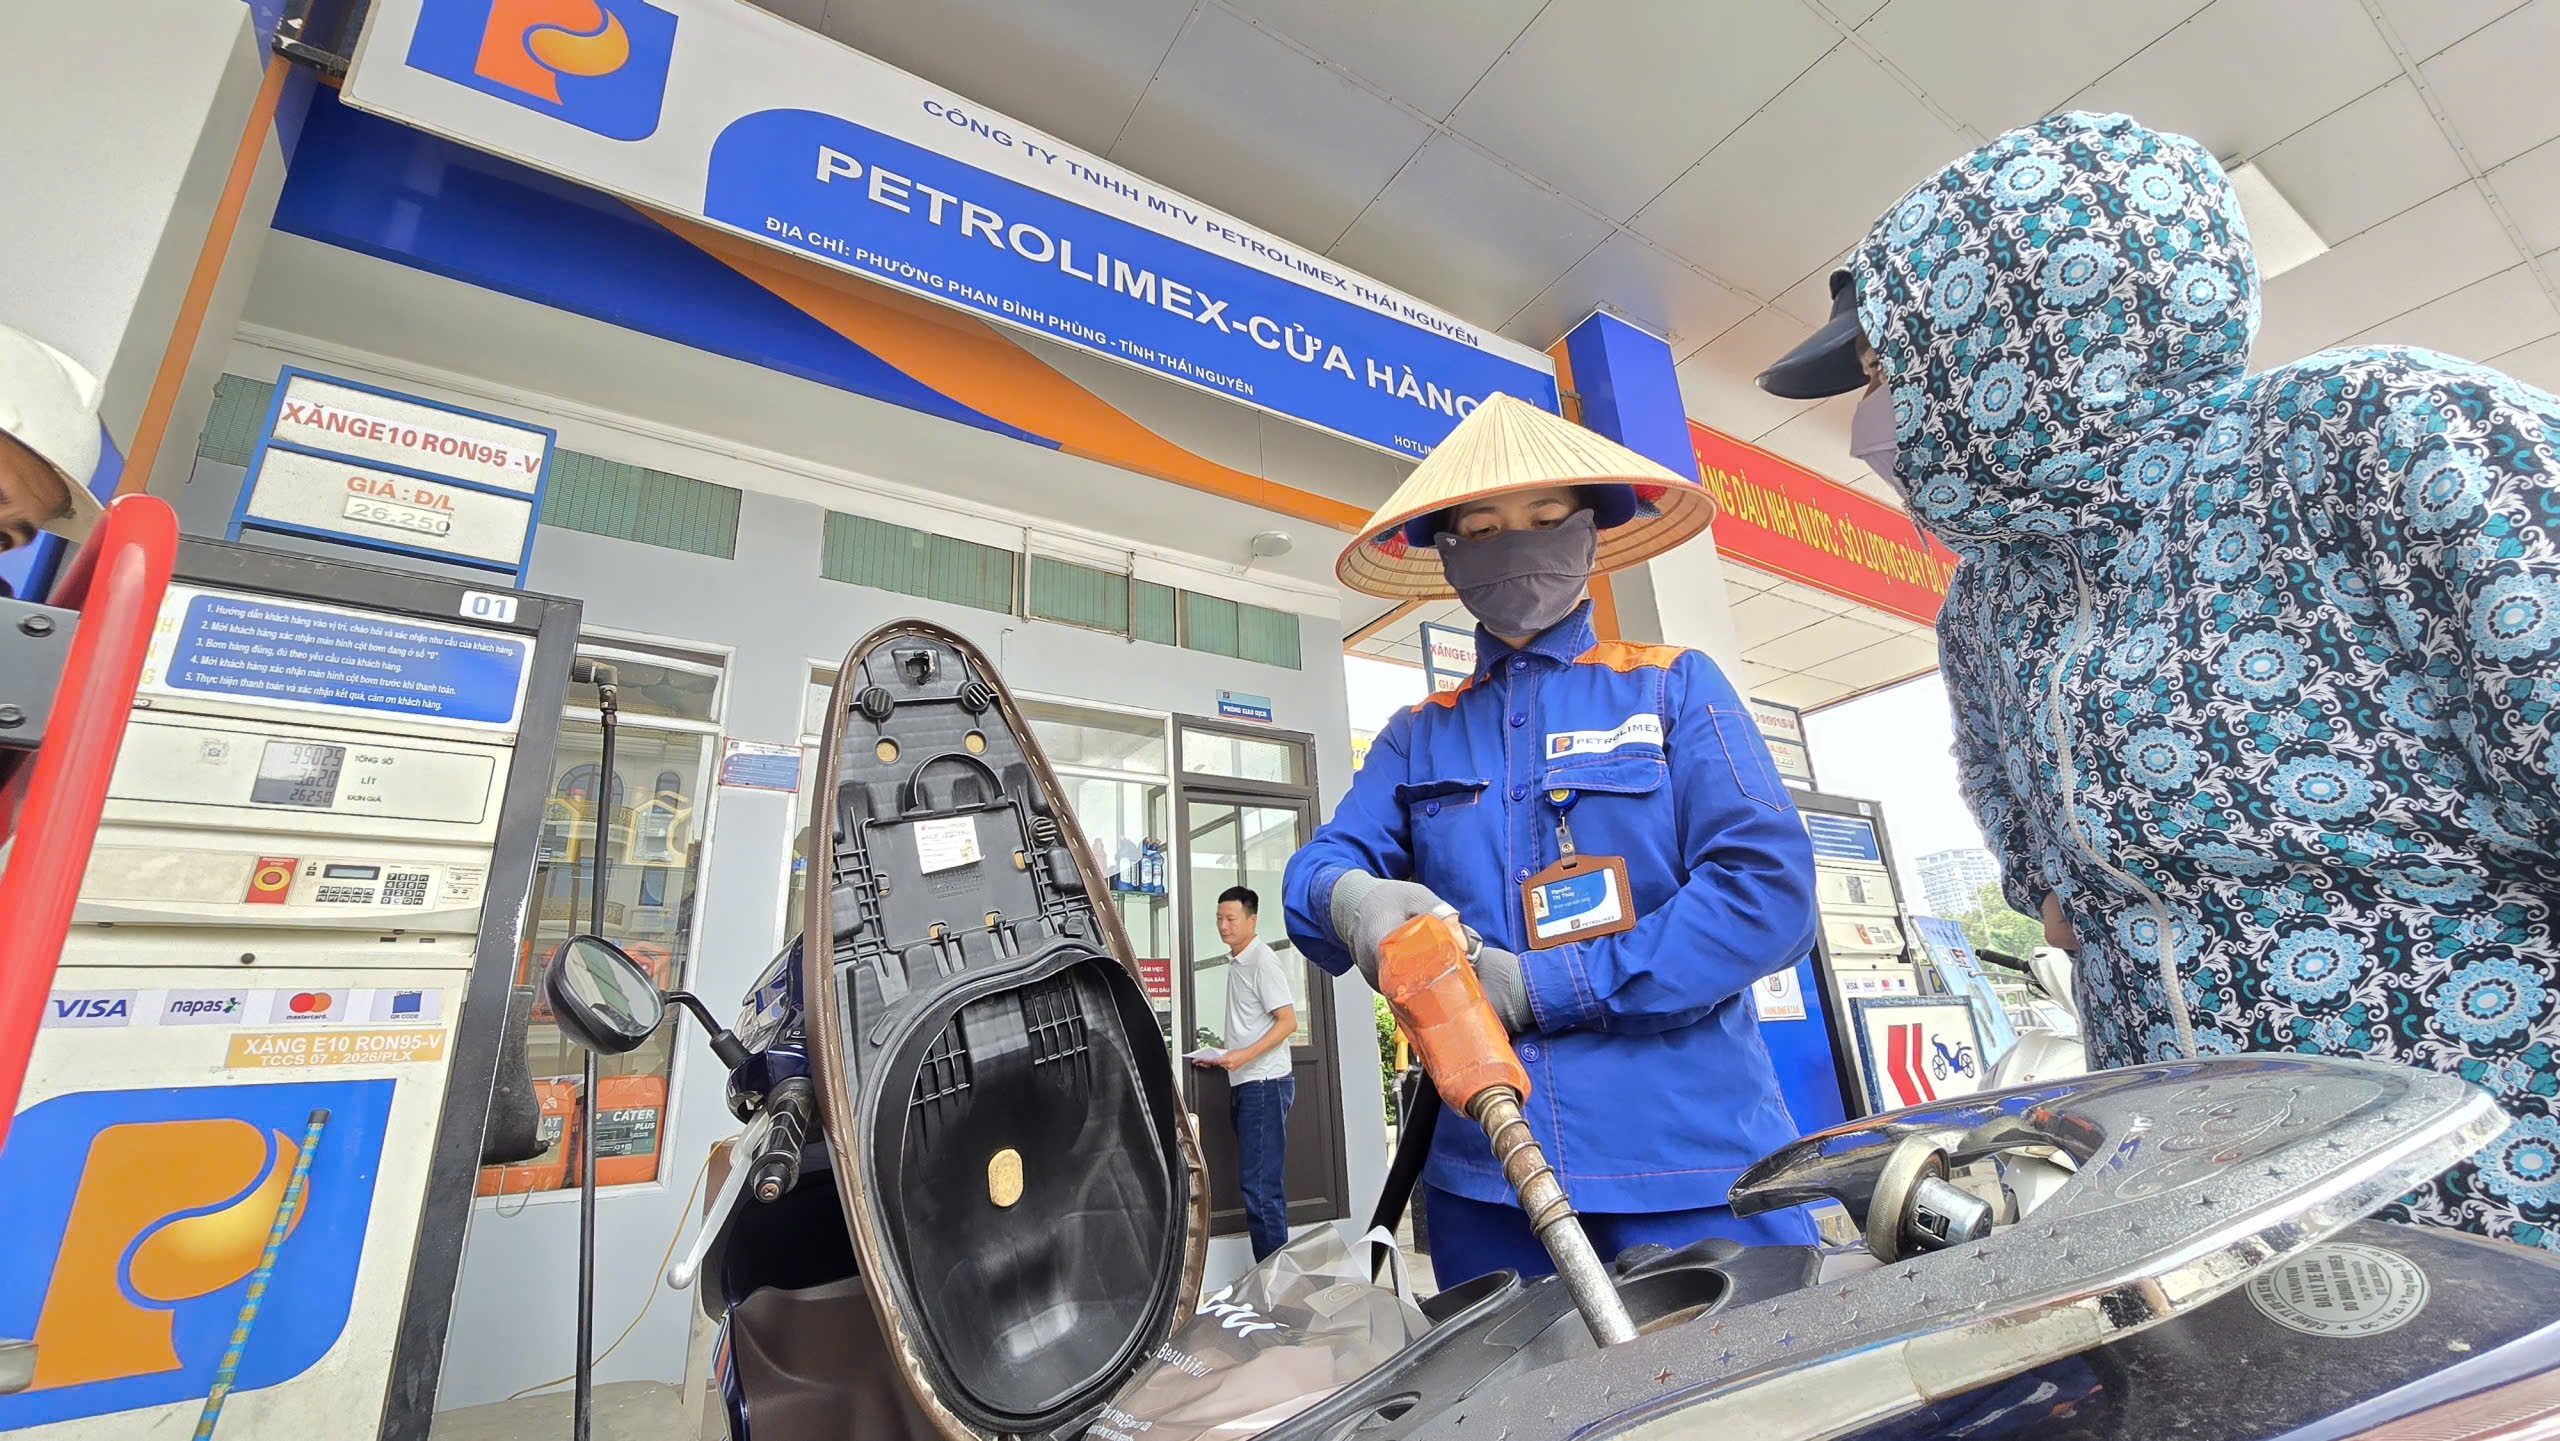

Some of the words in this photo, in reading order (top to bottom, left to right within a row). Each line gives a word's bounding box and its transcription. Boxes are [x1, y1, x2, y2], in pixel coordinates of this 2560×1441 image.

[923, 99, 1012, 147] CÔNG
[1023, 140, 1059, 166] TY
[1066, 158, 1139, 202] TNHH
[1147, 195, 1199, 227] MTV
[1206, 221, 1347, 291] PETROLIMEX
[1352, 283, 1397, 312] THÁI
[1403, 306, 1478, 346] NGUYÊN
[765, 216, 803, 241] ĐỊA
[808, 229, 851, 257] CHỈ:
[856, 248, 944, 290] PHƯỜNG
[948, 279, 999, 309] PHAN
[1002, 297, 1045, 325] ĐÌNH
[1048, 316, 1107, 347] PHÙNG
[1119, 336, 1155, 362] TỈNH
[1158, 352, 1193, 375] THÁI
[1195, 367, 1255, 396] NGUYÊN
[422, 432, 507, 468] RON95
[1394, 434, 1434, 455] HOTLIN
[347, 476, 396, 498] GIÁ
[1696, 448, 1735, 515] ĂNG
[1763, 484, 1801, 541] NHÀ
[1857, 527, 1905, 585] LƯỢNG
[472, 596, 507, 619] 01
[1577, 723, 1660, 745] PETROLIMEX
[52, 1000, 127, 1018] VISA
[170, 999, 223, 1016] napas
[243, 1032, 306, 1055] XĂNG
[312, 1034, 348, 1053] E10
[354, 1033, 442, 1053] RON95-V
[259, 1054, 306, 1066] TCCS
[309, 1053, 328, 1065] 07
[342, 1051, 413, 1065] 2026/PLX
[544, 1117, 562, 1128] AT
[613, 1109, 654, 1122] CATER
[634, 1122, 656, 1131] PLUS
[1156, 1342, 1213, 1378] Beautiful
